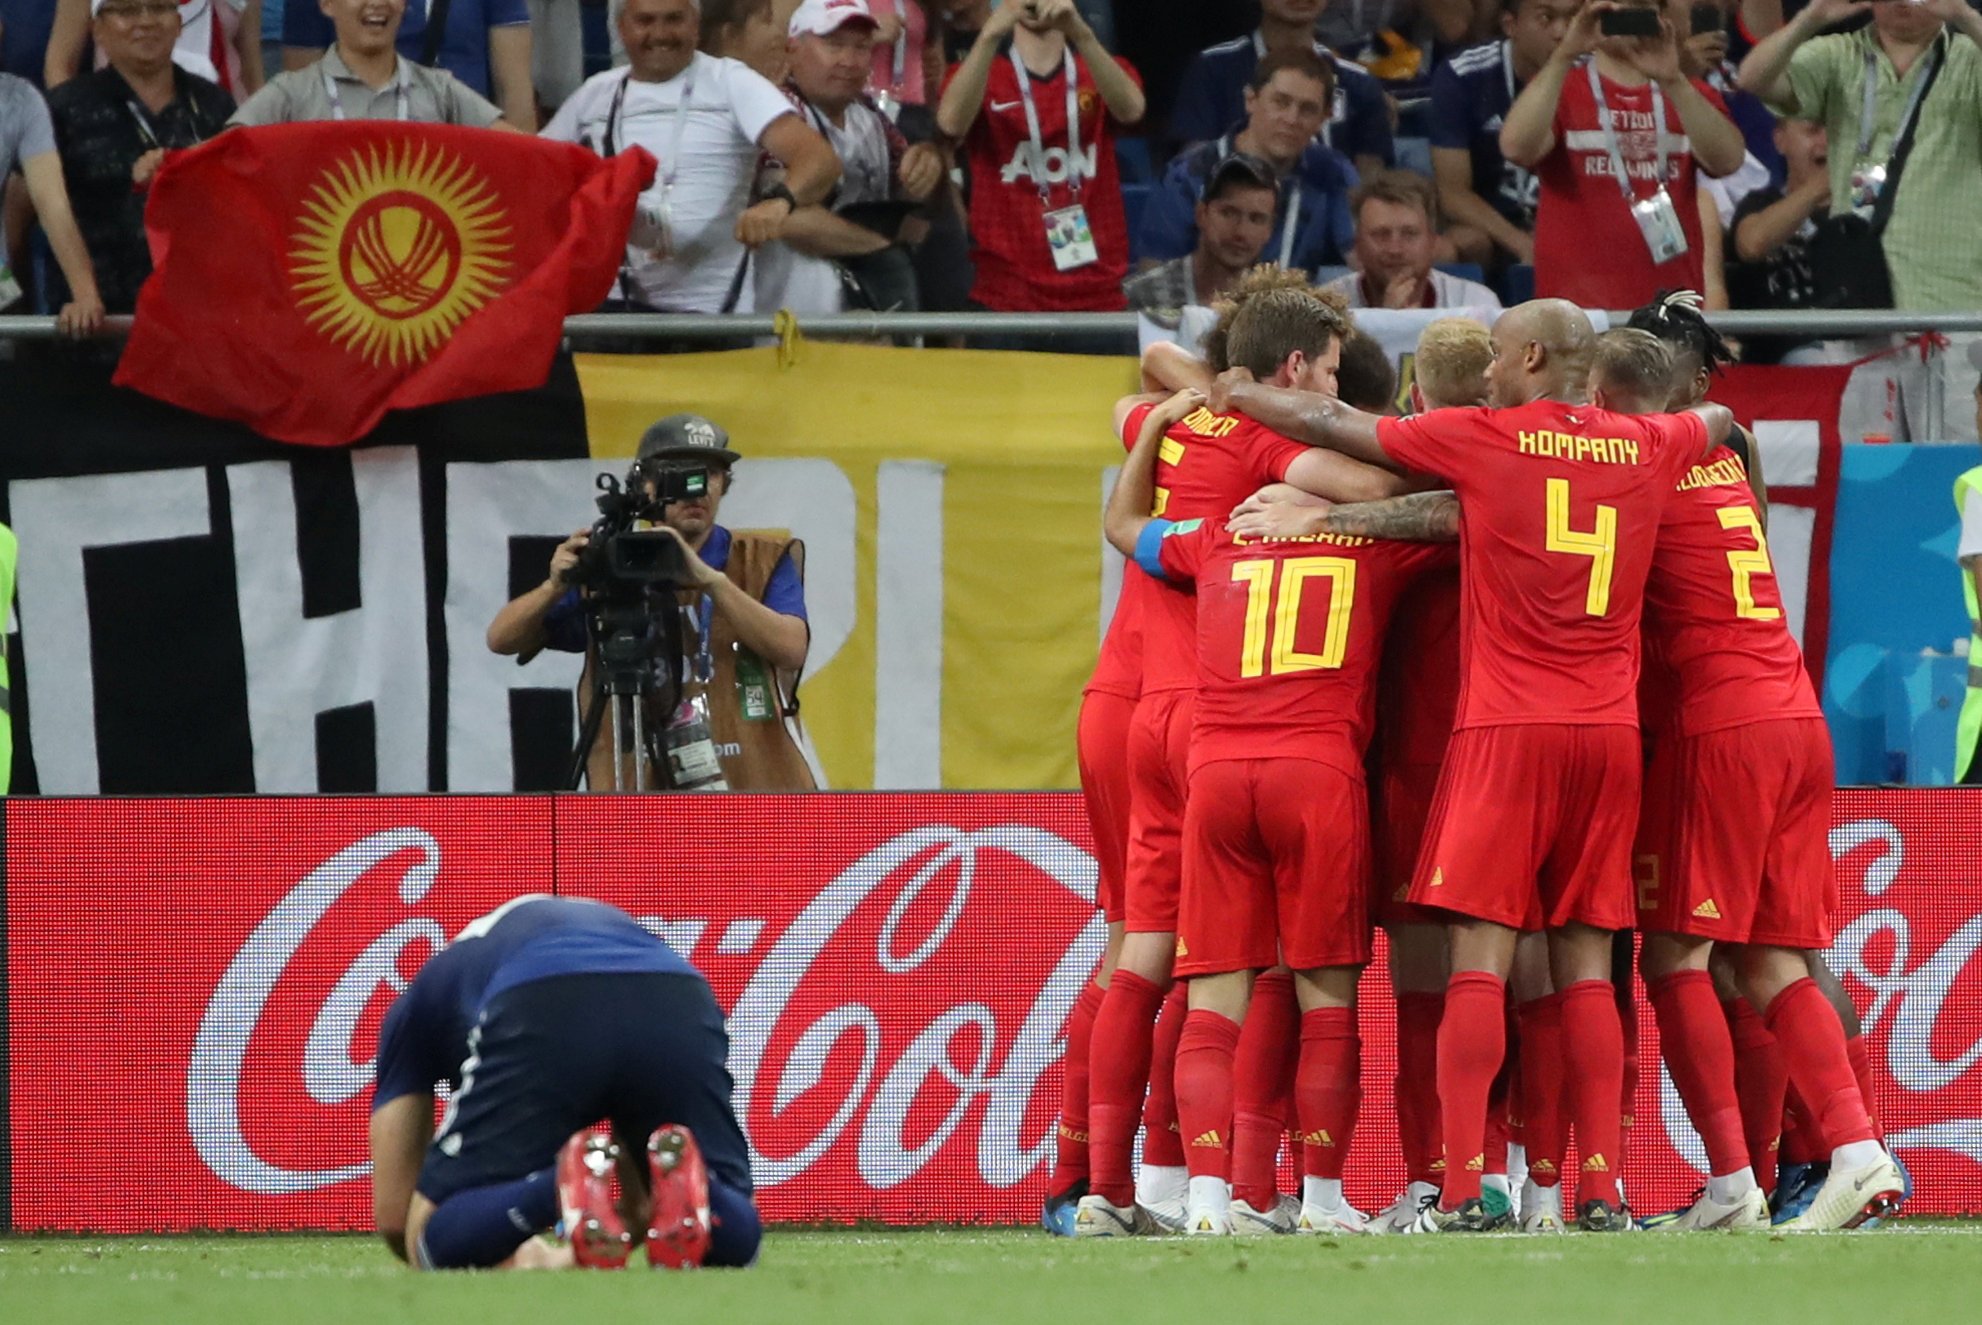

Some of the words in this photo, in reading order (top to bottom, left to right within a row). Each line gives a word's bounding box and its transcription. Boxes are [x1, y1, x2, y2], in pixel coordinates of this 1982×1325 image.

[1602, 109, 1662, 130] ETROI
[1624, 159, 1680, 180] WINS
[1518, 430, 1639, 465] KOMPANY
[1546, 478, 1618, 617] 4
[1716, 506, 1781, 621] 2
[1231, 556, 1357, 679] 10
